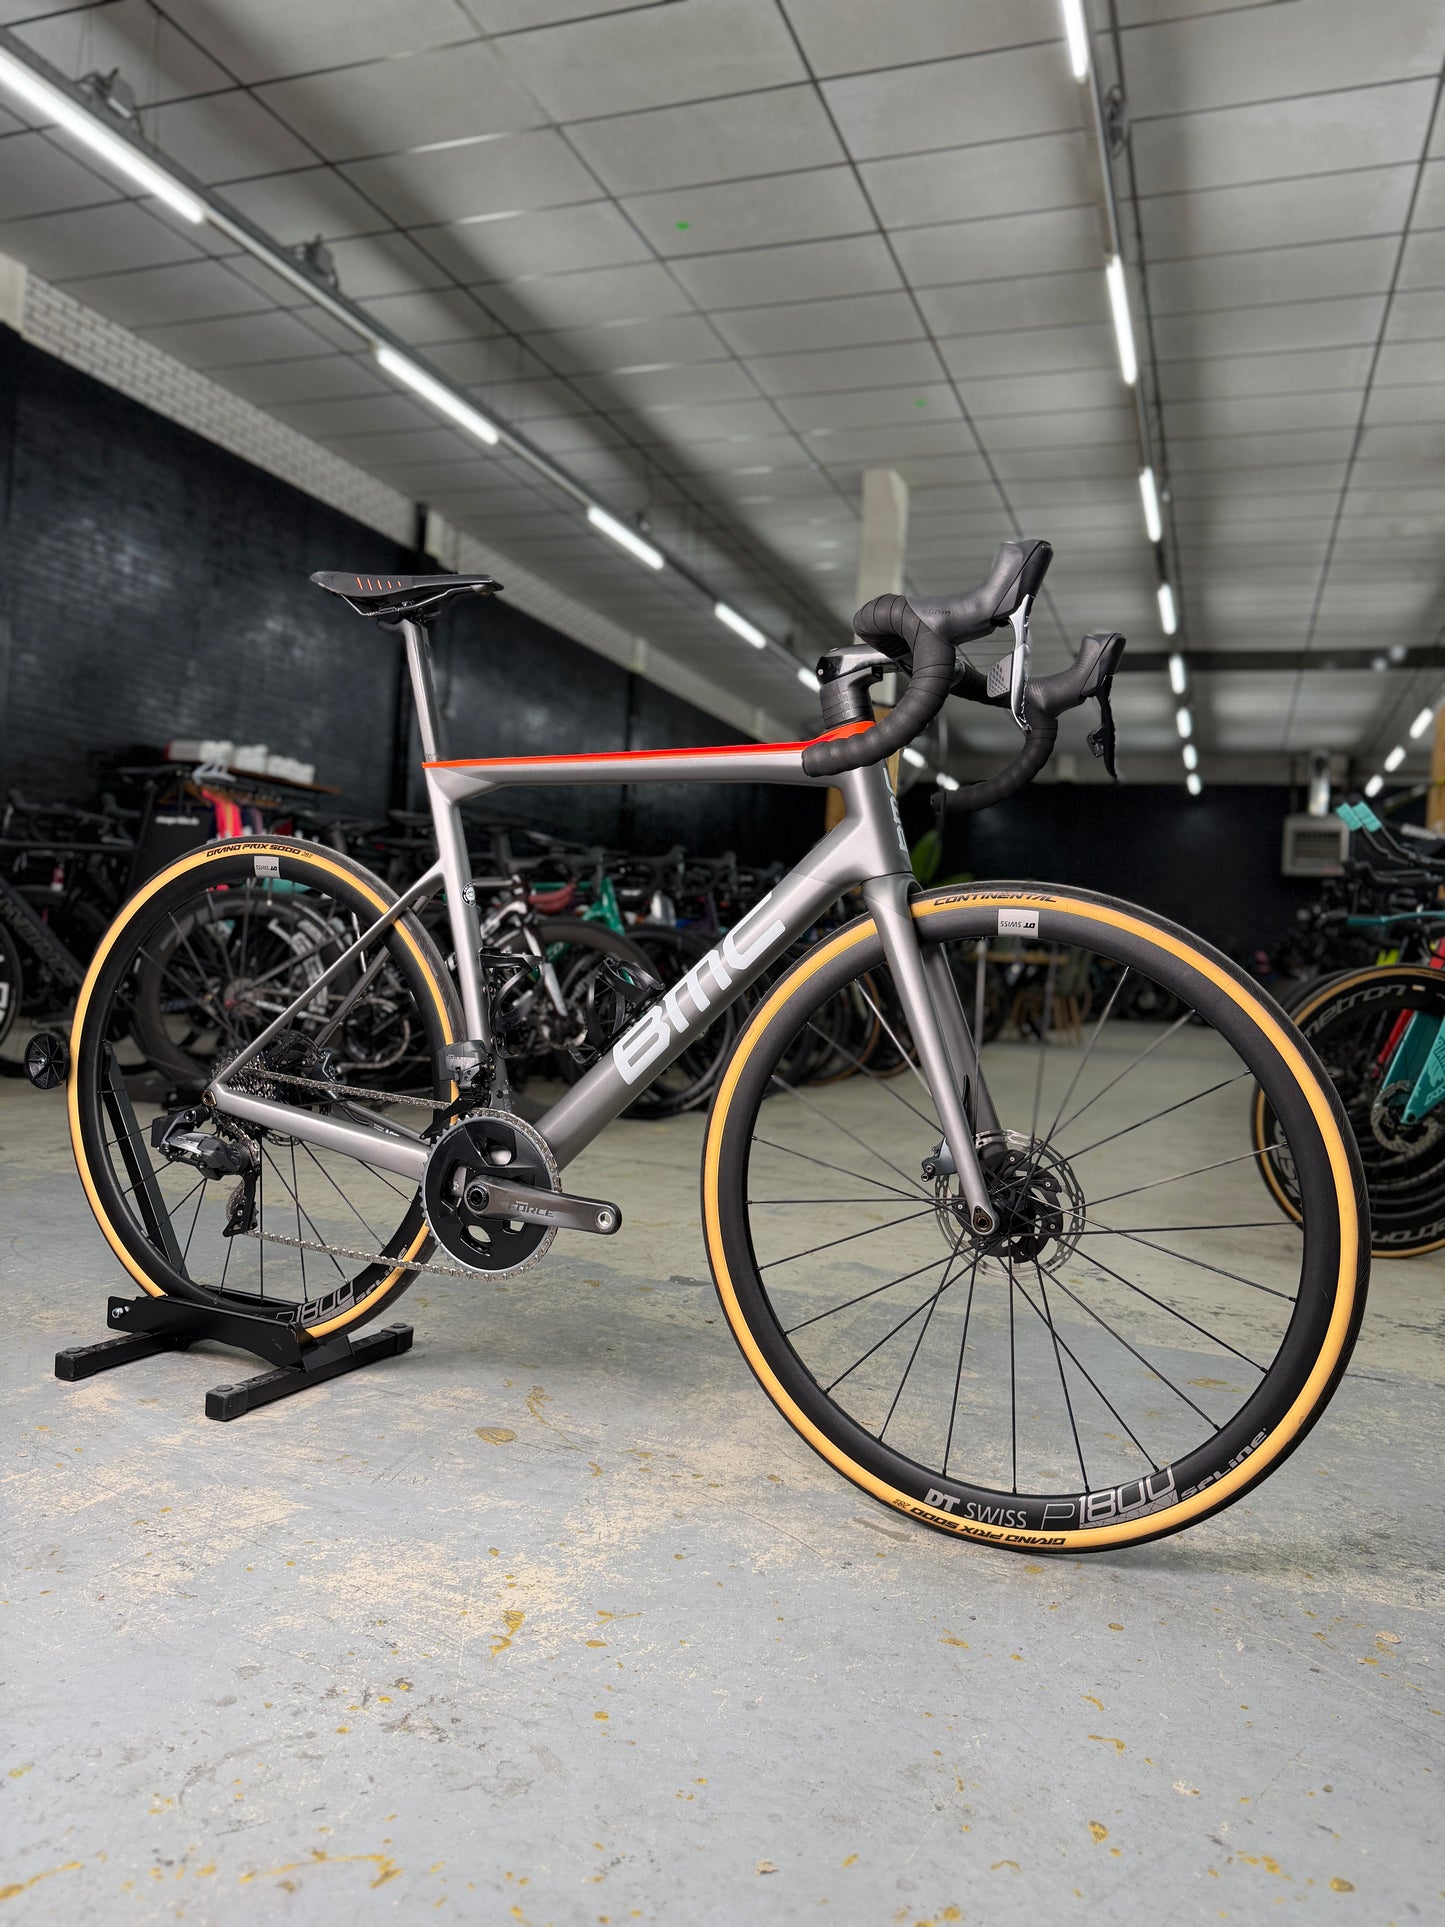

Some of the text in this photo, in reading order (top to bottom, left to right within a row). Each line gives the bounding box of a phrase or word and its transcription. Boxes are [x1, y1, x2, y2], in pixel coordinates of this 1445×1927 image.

[206, 844, 242, 857] GRAND
[270, 844, 301, 855] 5000
[933, 891, 1057, 906] CONTINENTAL
[1000, 920, 1022, 928] SWISS
[613, 891, 786, 1085] BMC
[510, 1203, 554, 1218] FORCE
[923, 1487, 961, 1512] DT
[964, 1502, 1027, 1529] SWISS
[911, 1507, 959, 1529] 5000
[963, 1525, 1003, 1541] PRIX
[1004, 1534, 1067, 1546] GRAND
